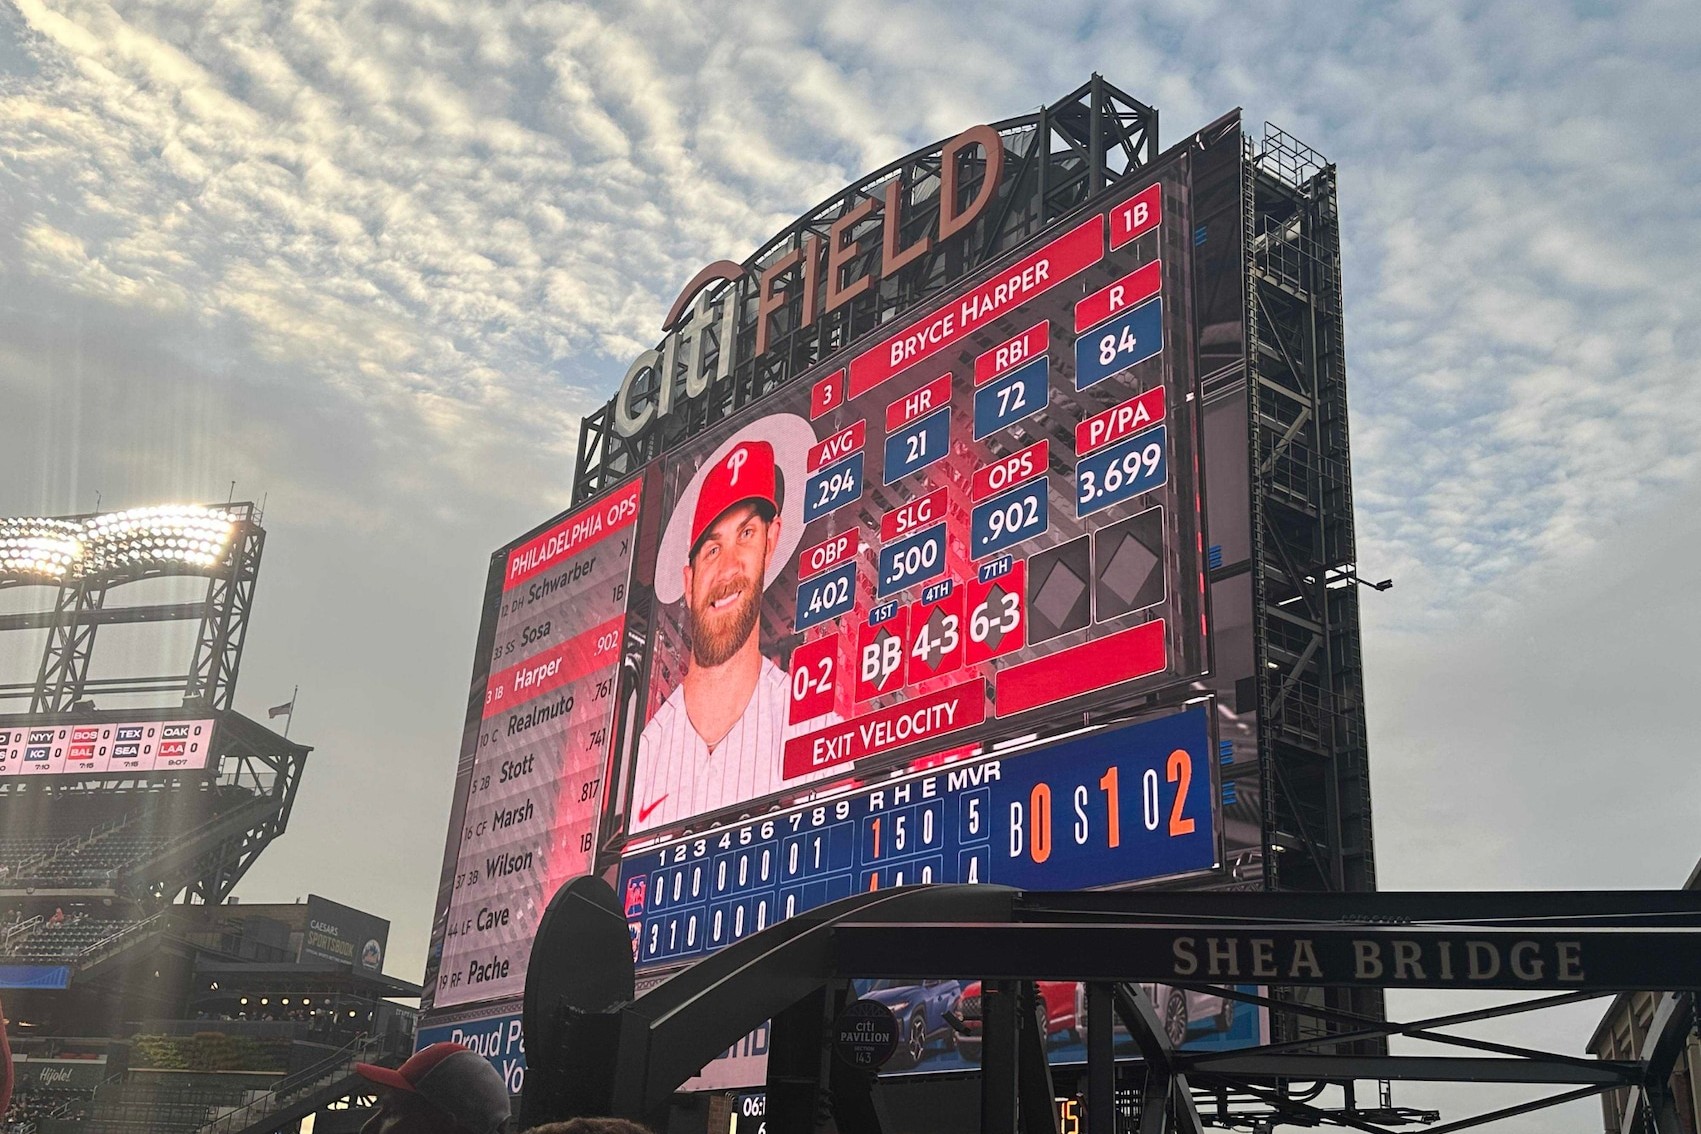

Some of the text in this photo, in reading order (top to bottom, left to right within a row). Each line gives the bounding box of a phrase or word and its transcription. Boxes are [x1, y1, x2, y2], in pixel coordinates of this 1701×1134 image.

[614, 124, 1005, 438] citi FIELD
[1108, 284, 1125, 309] R
[823, 202, 1149, 405] 3 BRYCE HARPER 1B
[995, 334, 1029, 373] RBI
[1099, 325, 1136, 366] 84
[905, 389, 932, 420] HR
[997, 381, 1026, 418] 72
[1090, 401, 1150, 446] P/PA
[819, 431, 853, 465] AVG
[906, 430, 927, 464] 21
[727, 448, 748, 487] P
[988, 451, 1033, 489] OPS
[1079, 443, 1161, 504] 3.699
[813, 468, 855, 509] .294
[511, 494, 636, 578] PHILADELPHIA OPS
[897, 499, 931, 533] SLG
[982, 496, 1039, 545] .902
[811, 538, 847, 569] OBP
[885, 538, 937, 584] .500
[983, 559, 1008, 580] 7TH
[511, 595, 524, 613] DH
[528, 557, 595, 604] Schwarber
[803, 576, 849, 619] .402
[926, 582, 949, 601] 4TH
[505, 641, 515, 655] SS
[521, 622, 551, 647] Sosa
[612, 585, 623, 602] 1B
[874, 604, 893, 622] 1ST
[970, 592, 1021, 644] 6-3
[911, 614, 959, 662] 4-3
[486, 631, 618, 704] 3 1B Harper .902
[861, 635, 902, 683] BB
[792, 657, 833, 702] 0-2
[120, 728, 155, 738] TEX 0
[164, 726, 202, 736] OAK 0
[480, 679, 611, 748] 10 C Realmuto .761
[812, 699, 959, 766] EXIT VELOCITY
[30, 748, 62, 758] KC 0
[31, 730, 66, 742] NYY 0
[71, 746, 106, 756] BAL 0
[74, 730, 110, 740] BOS 0
[115, 745, 151, 755] SEA 0
[161, 743, 198, 753] LAA 0
[472, 728, 606, 794] 5 2B Stott .741
[476, 821, 487, 837] CF
[492, 799, 533, 831] Marsh
[578, 779, 600, 803] .817
[659, 760, 1000, 866] 1 2 3 4 5 6 7 8 9 R H E MVR
[1010, 802, 1023, 857] B
[1030, 783, 1051, 863] 0
[1074, 785, 1088, 844] S
[1100, 767, 1120, 848] 1
[1166, 749, 1195, 837] 2
[456, 833, 592, 889] 37 3B Wilson 1B
[655, 876, 664, 905] 0
[673, 872, 682, 901] 0
[692, 867, 701, 897] 0
[718, 861, 726, 891] 0
[740, 855, 748, 886] 0
[761, 850, 770, 881] 0
[789, 842, 798, 874] 0
[814, 837, 821, 868] 1
[872, 818, 881, 858] 1
[896, 816, 906, 850] 5
[924, 809, 933, 844] 0
[969, 799, 979, 834] 5
[461, 920, 472, 936] LF
[477, 908, 509, 931] Cave
[650, 924, 658, 954] 3
[670, 920, 677, 949] 1
[688, 915, 697, 946] 0
[714, 910, 722, 941] 0
[735, 905, 744, 937] 0
[758, 900, 766, 931] 0
[968, 857, 978, 884] 4
[308, 931, 355, 957] SPORTSBOOK
[310, 920, 339, 937] CAESARS
[450, 972, 462, 988] RF
[467, 956, 509, 984] Pache
[1172, 936, 1586, 981] SHEA BRIDGE
[840, 1032, 890, 1042] PAVILION
[856, 1052, 872, 1064] 143
